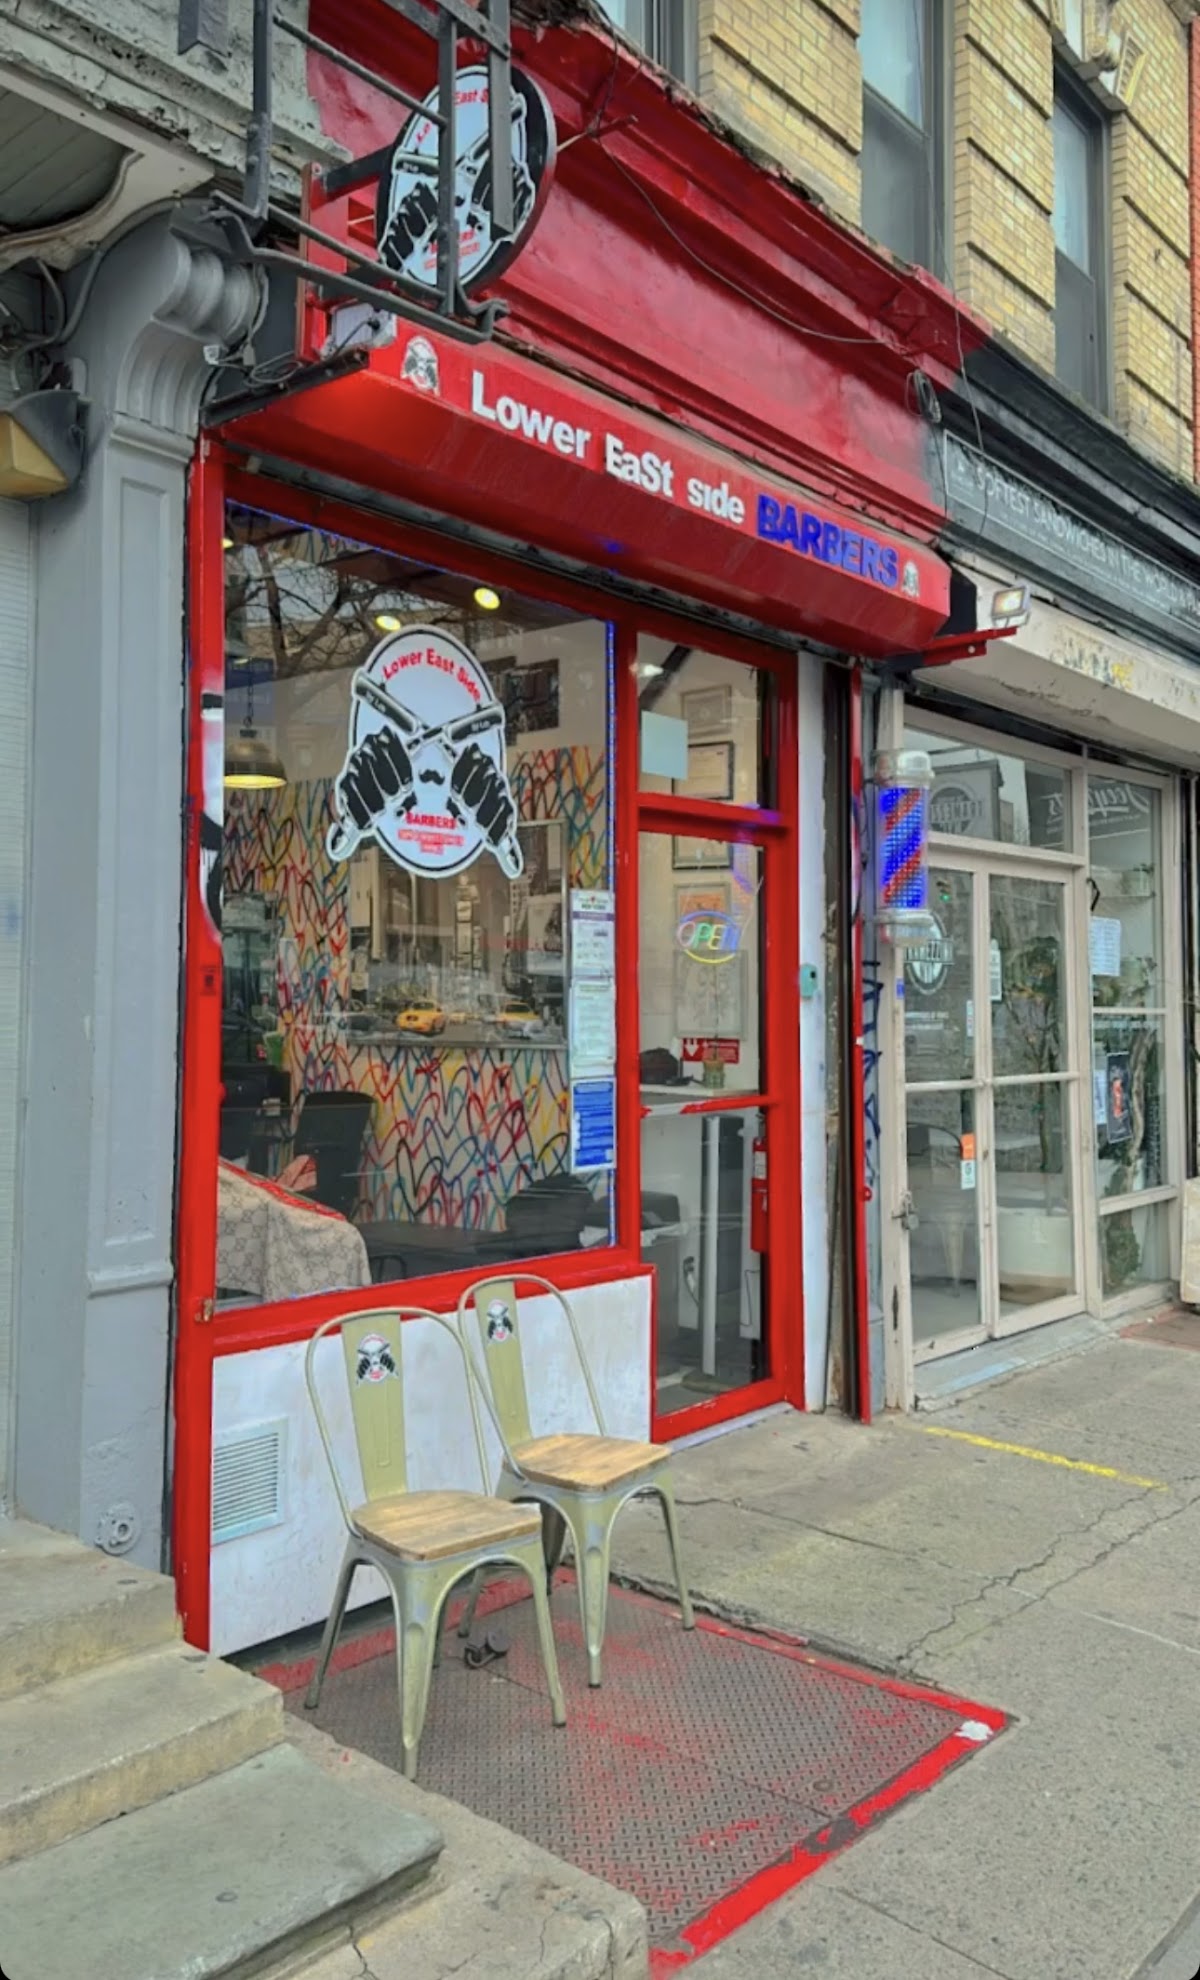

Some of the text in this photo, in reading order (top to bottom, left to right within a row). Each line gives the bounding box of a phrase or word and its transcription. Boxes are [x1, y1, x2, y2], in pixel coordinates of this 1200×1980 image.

[472, 369, 591, 459] Lower
[756, 493, 898, 588] BARBERS
[383, 647, 481, 703] Lower East Side
[405, 811, 457, 830] BARBERS
[677, 921, 741, 953] OPEN
